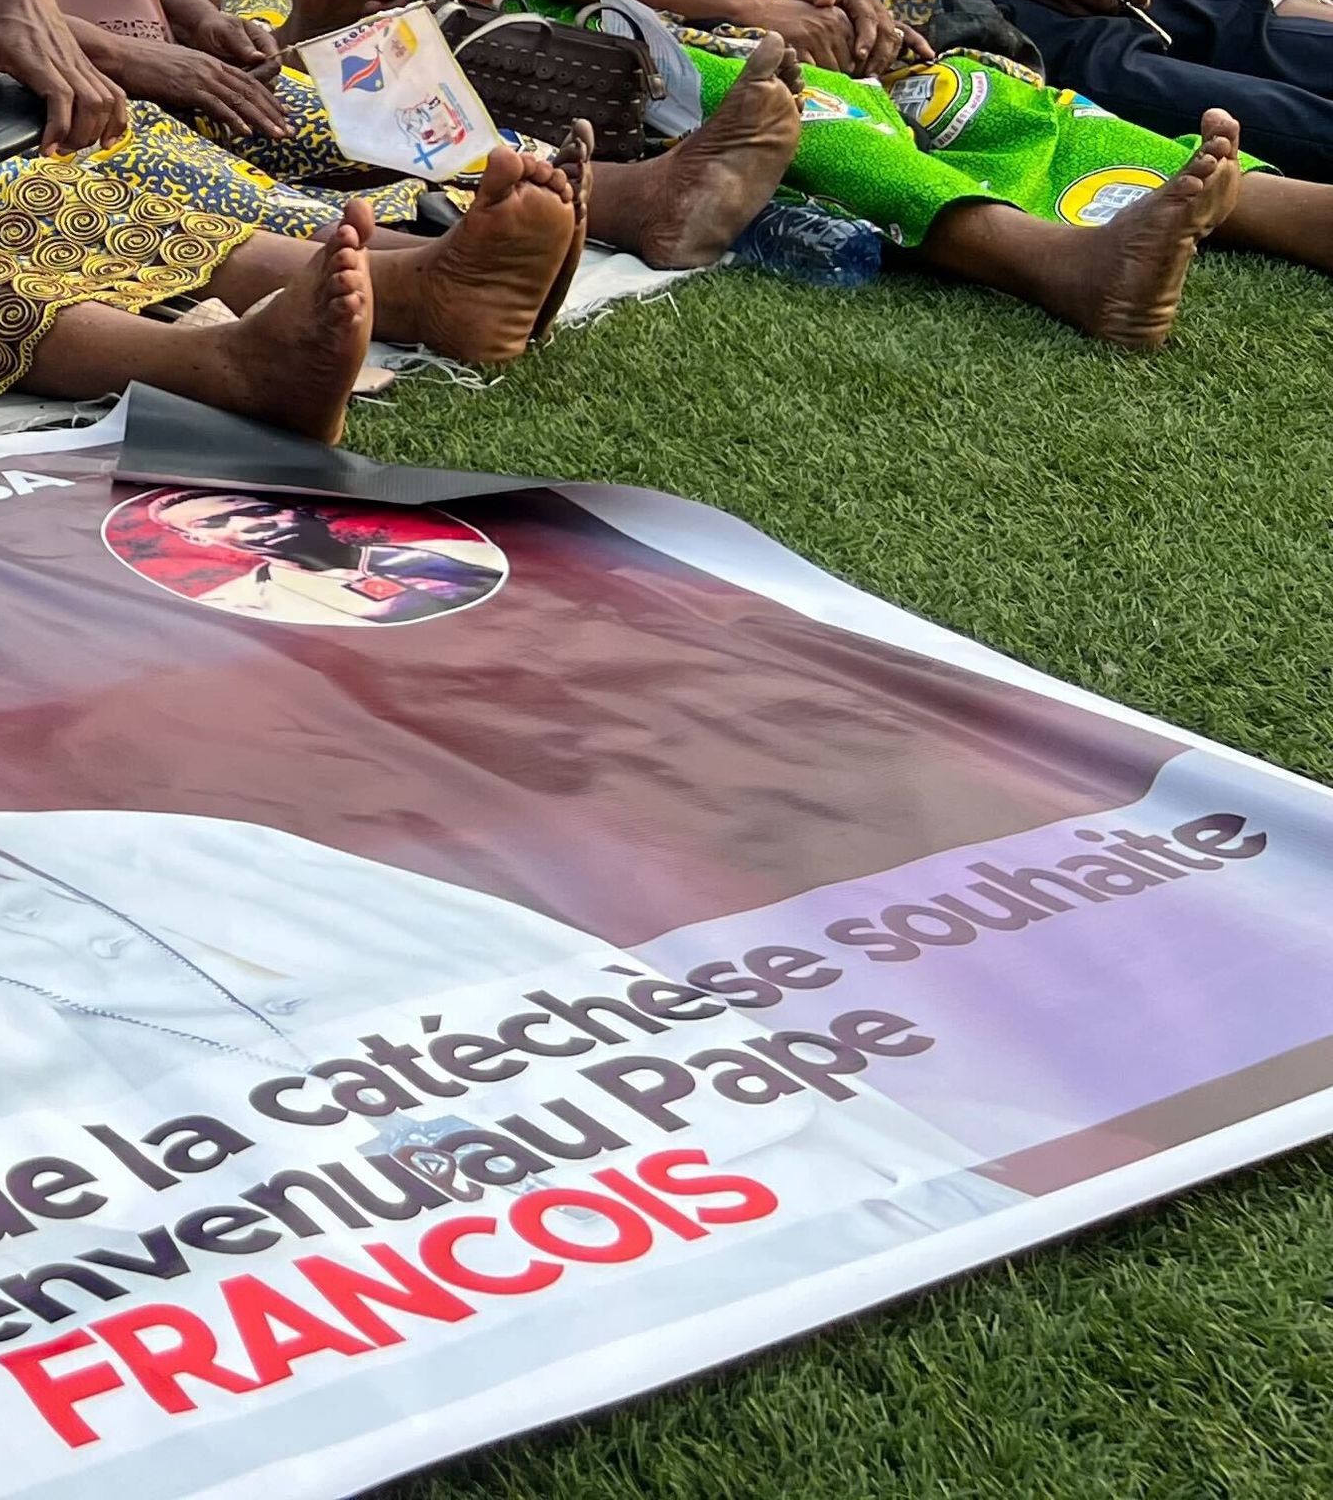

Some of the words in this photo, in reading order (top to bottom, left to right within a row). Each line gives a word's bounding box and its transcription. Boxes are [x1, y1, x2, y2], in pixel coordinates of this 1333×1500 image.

[85, 1121, 255, 1194] la
[247, 942, 839, 1126] catéchèse
[822, 811, 1266, 965] souhaite
[433, 1097, 632, 1186] au
[577, 1001, 936, 1138] Pape
